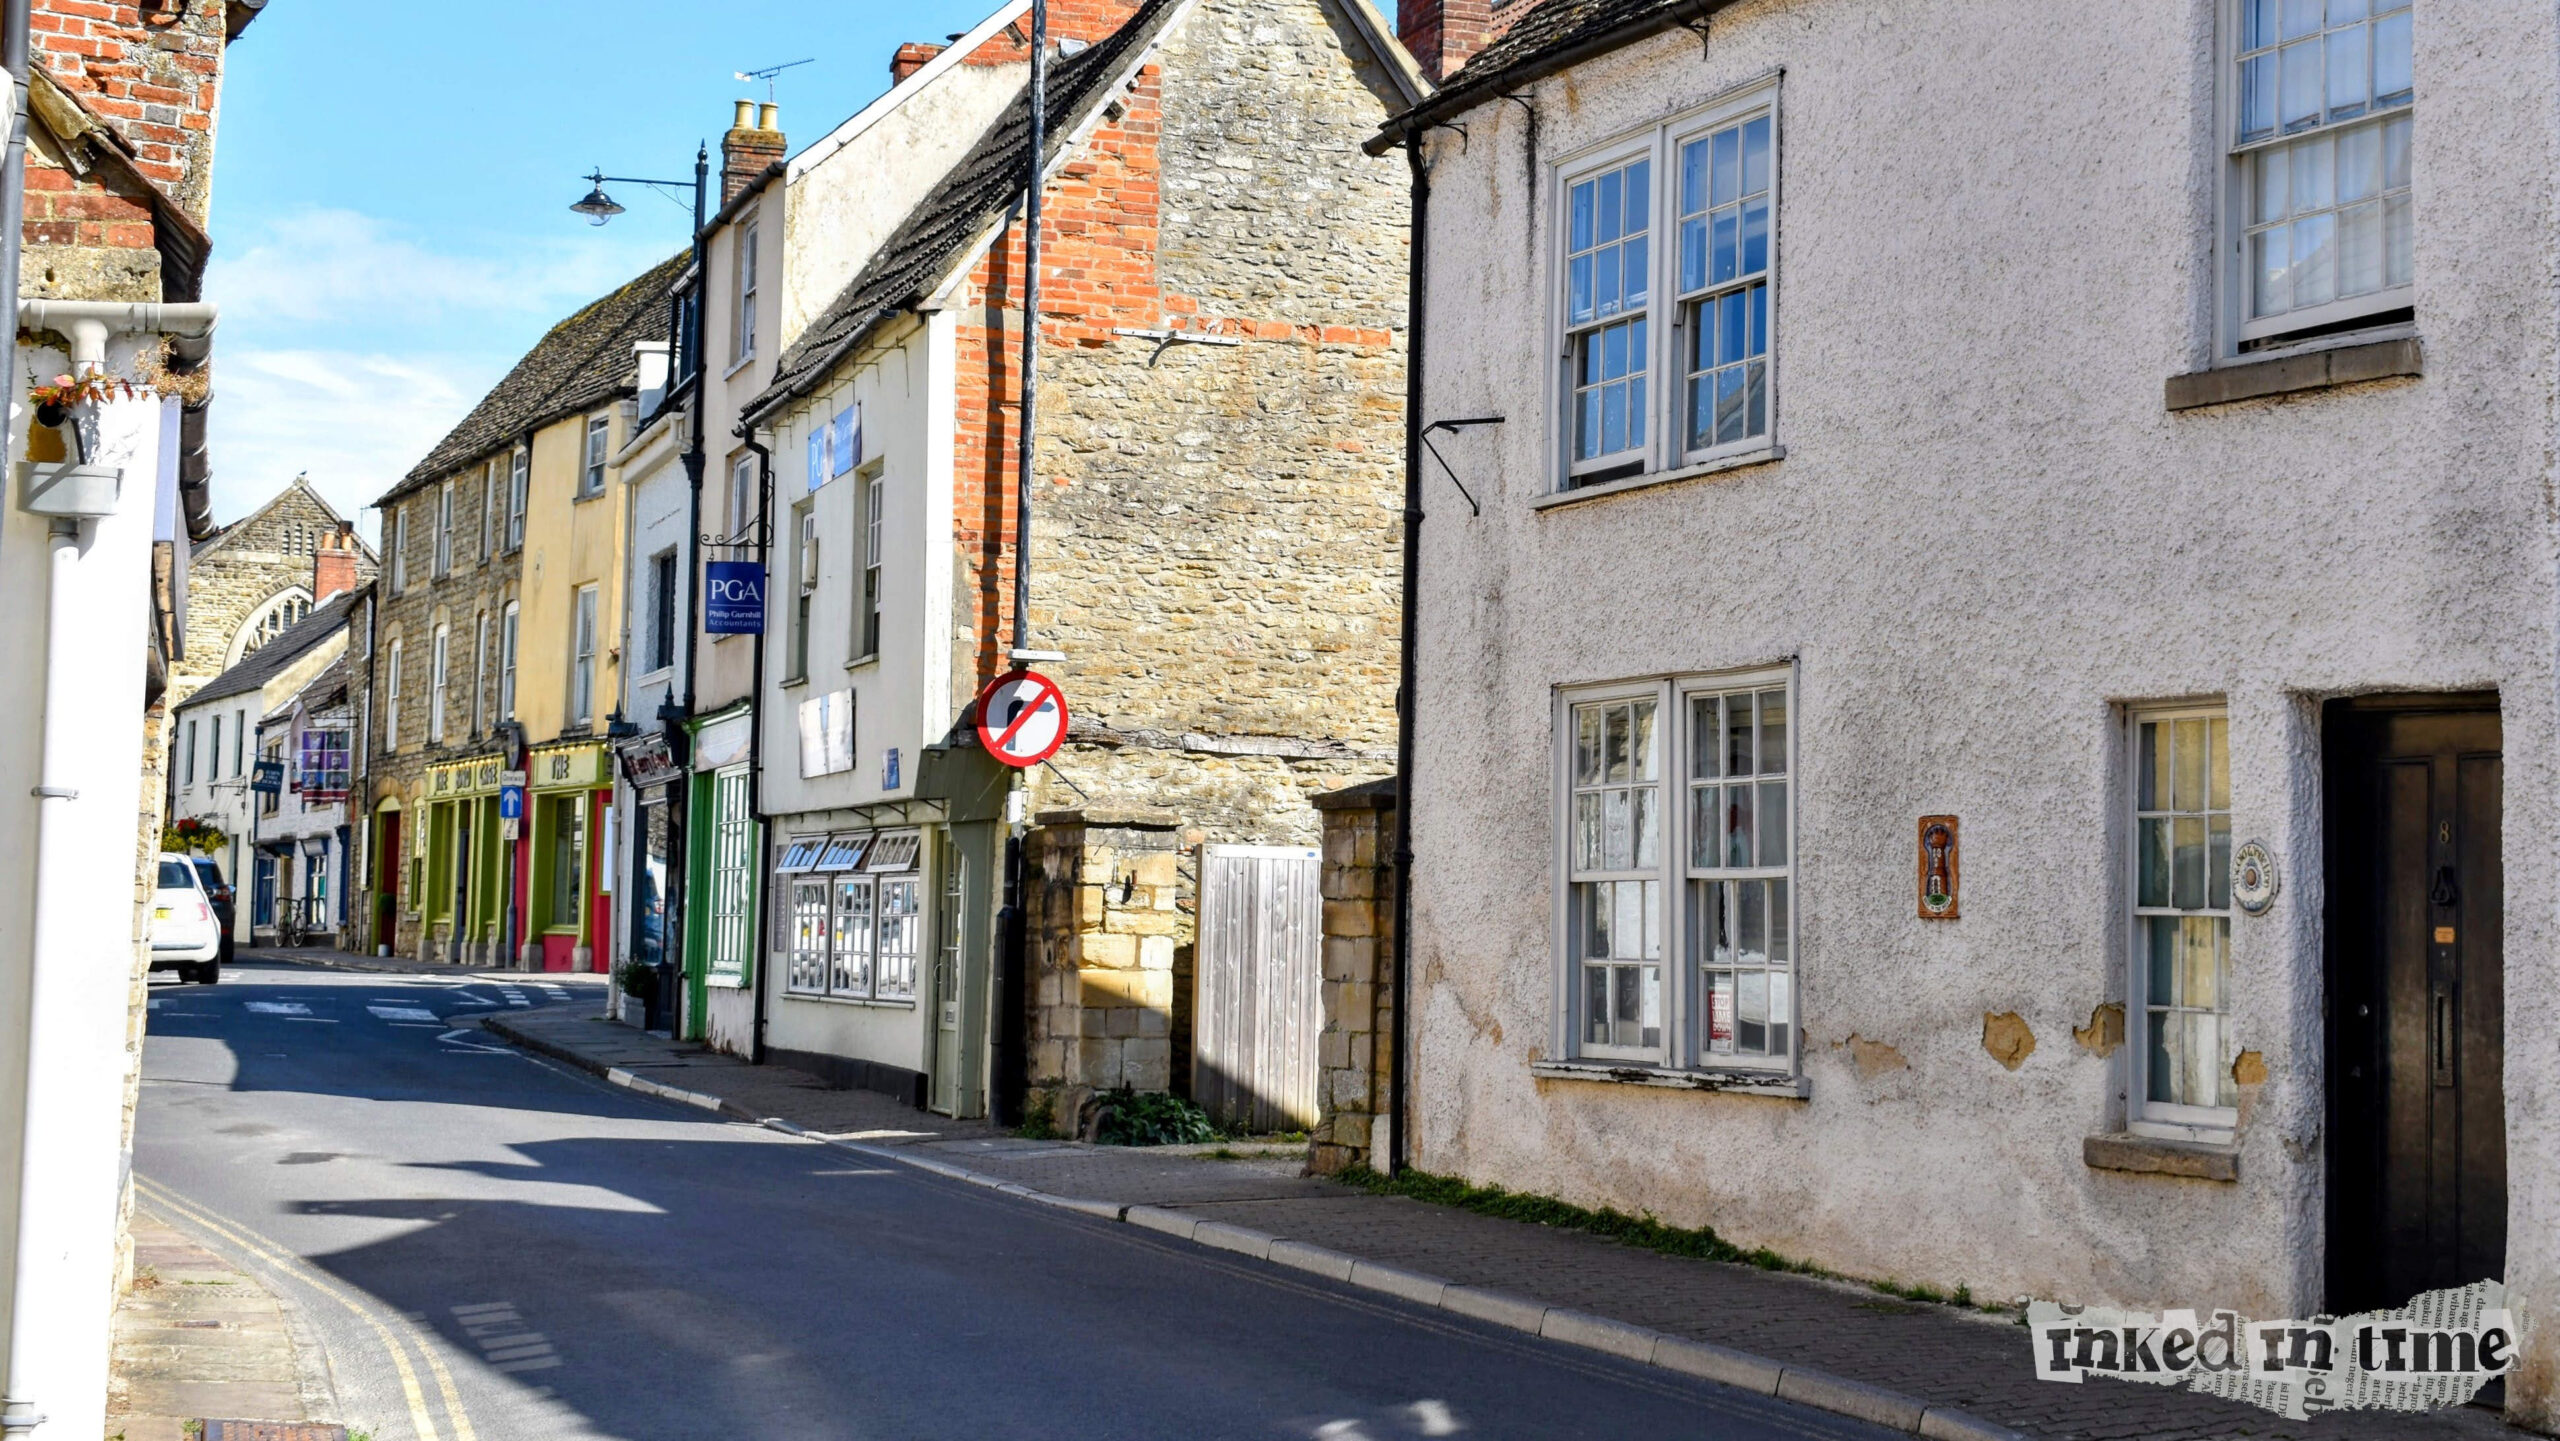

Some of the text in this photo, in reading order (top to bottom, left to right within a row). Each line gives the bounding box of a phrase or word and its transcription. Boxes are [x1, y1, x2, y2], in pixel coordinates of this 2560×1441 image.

[709, 579, 761, 602] PGA
[709, 610, 730, 619] Philip
[2440, 820, 2450, 844] 8
[1712, 997, 1729, 1007] STOP
